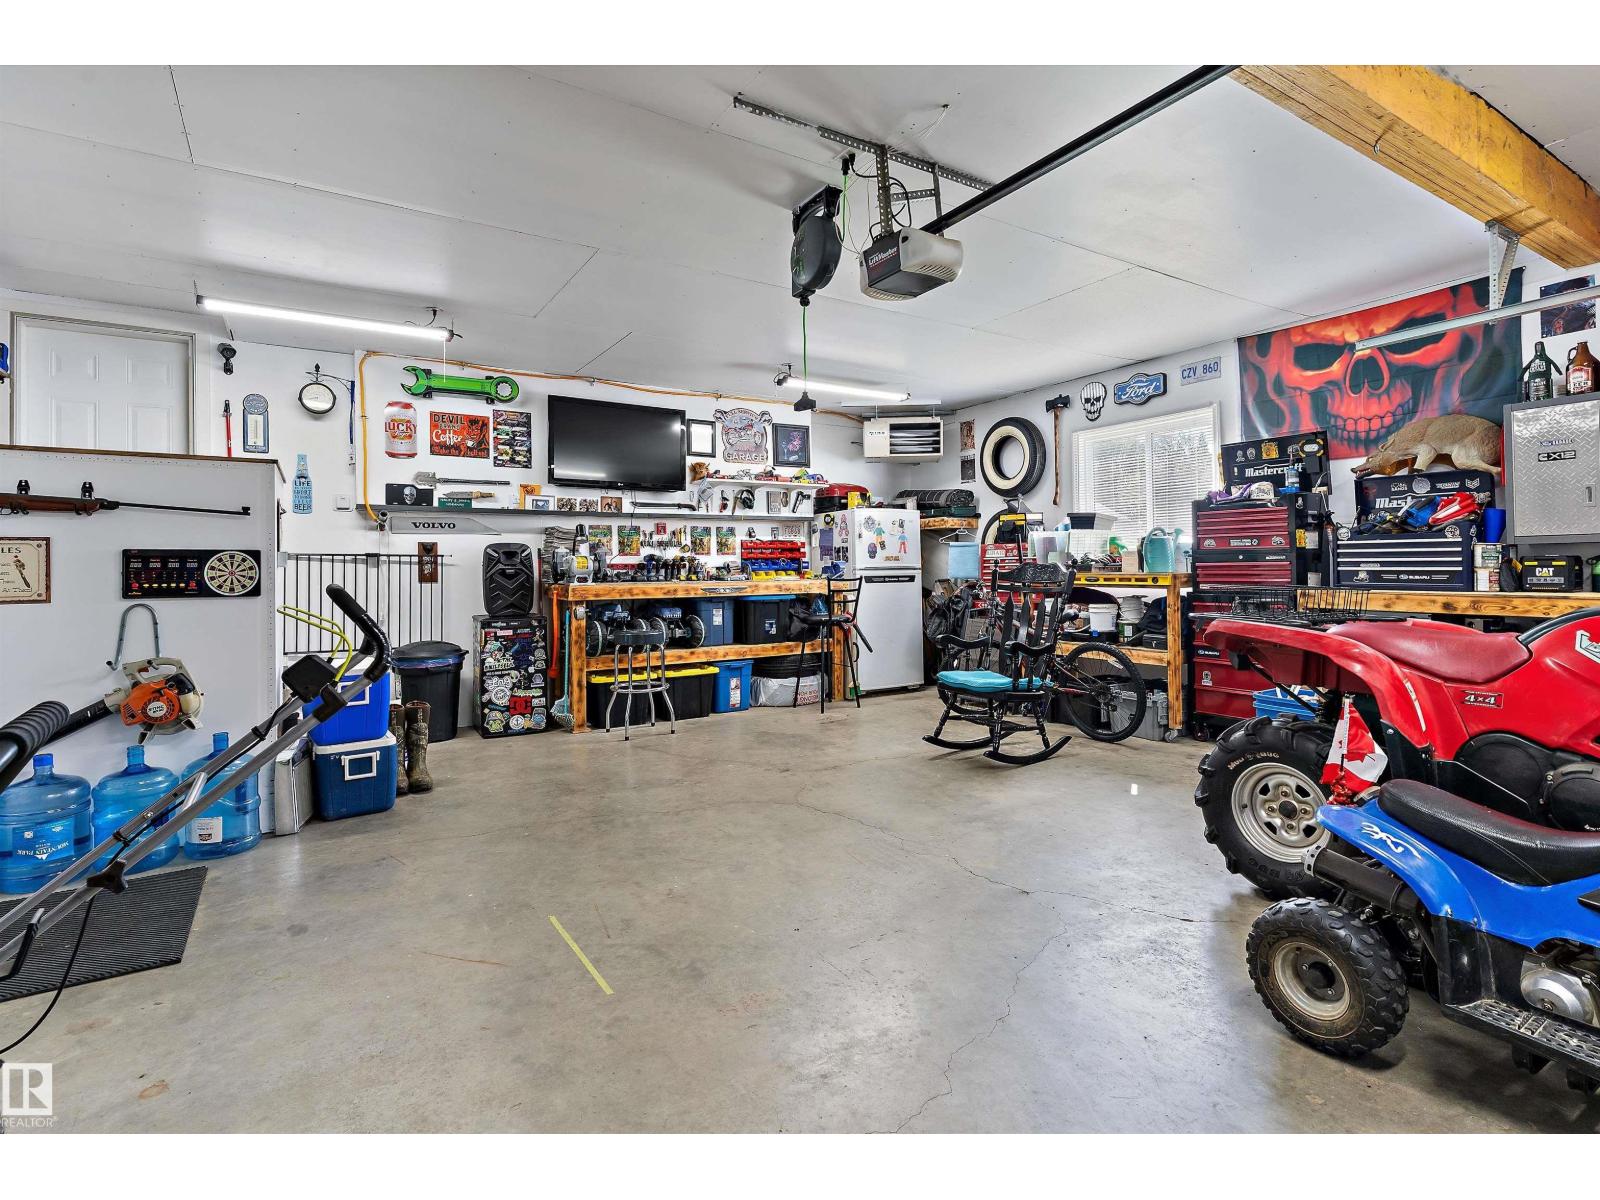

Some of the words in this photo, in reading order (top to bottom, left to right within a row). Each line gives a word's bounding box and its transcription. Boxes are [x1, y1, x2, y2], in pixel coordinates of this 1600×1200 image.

[1181, 366, 1197, 380] CZV
[1202, 361, 1219, 375] 860
[1121, 381, 1157, 399] Ford
[433, 413, 466, 425] DEVIL
[384, 421, 417, 435] LUCKY
[432, 429, 463, 446] Coffee
[725, 452, 766, 463] GARAGE
[294, 503, 312, 511] BEER
[411, 521, 456, 530] VOLVO
[1535, 567, 1555, 577] CAT
